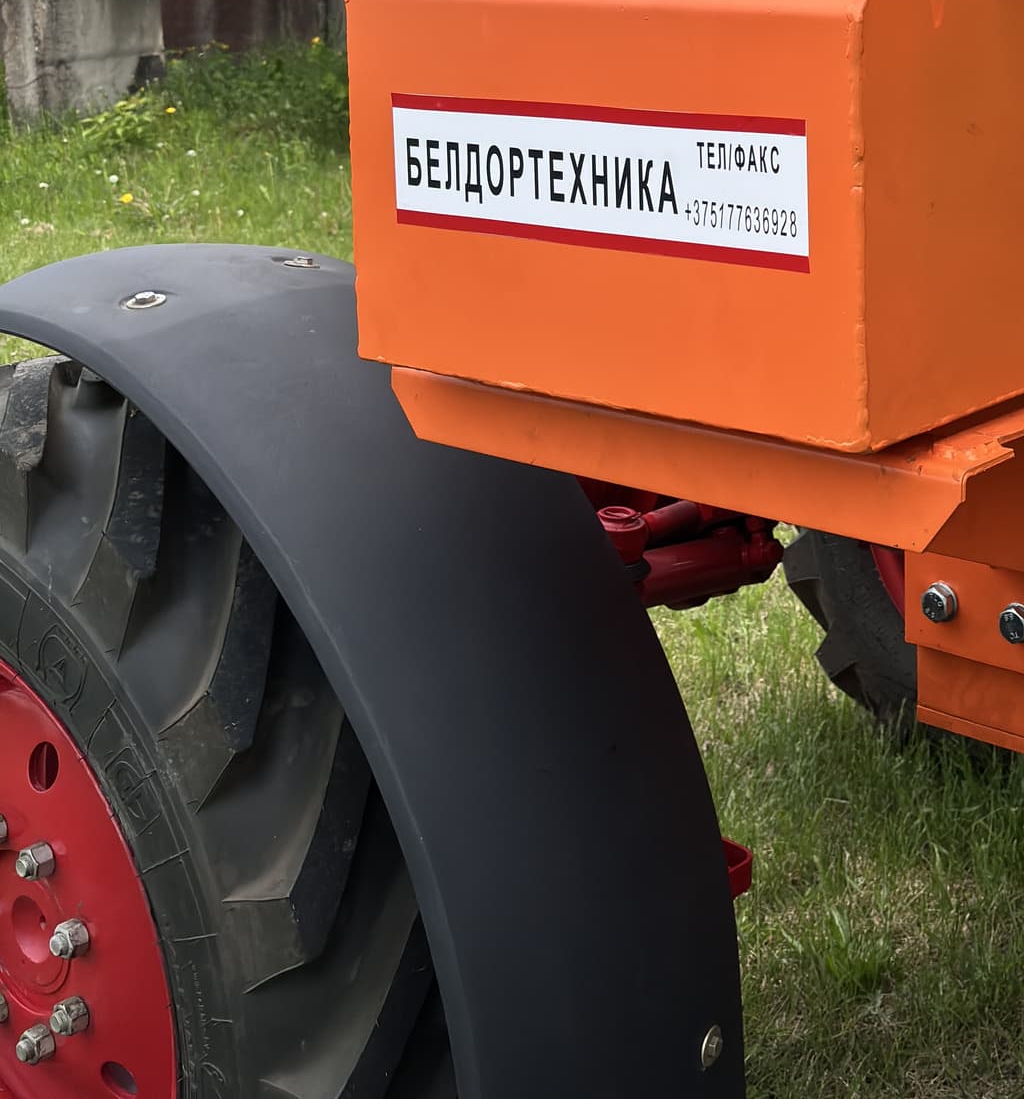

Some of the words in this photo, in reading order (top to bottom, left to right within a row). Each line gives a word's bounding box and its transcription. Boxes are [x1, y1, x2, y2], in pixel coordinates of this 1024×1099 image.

[406, 137, 679, 215] БЕЛДОРТЕХНИКА
[696, 141, 781, 175] ТЕЛ/ФАКС
[684, 199, 798, 239] +375177636928
